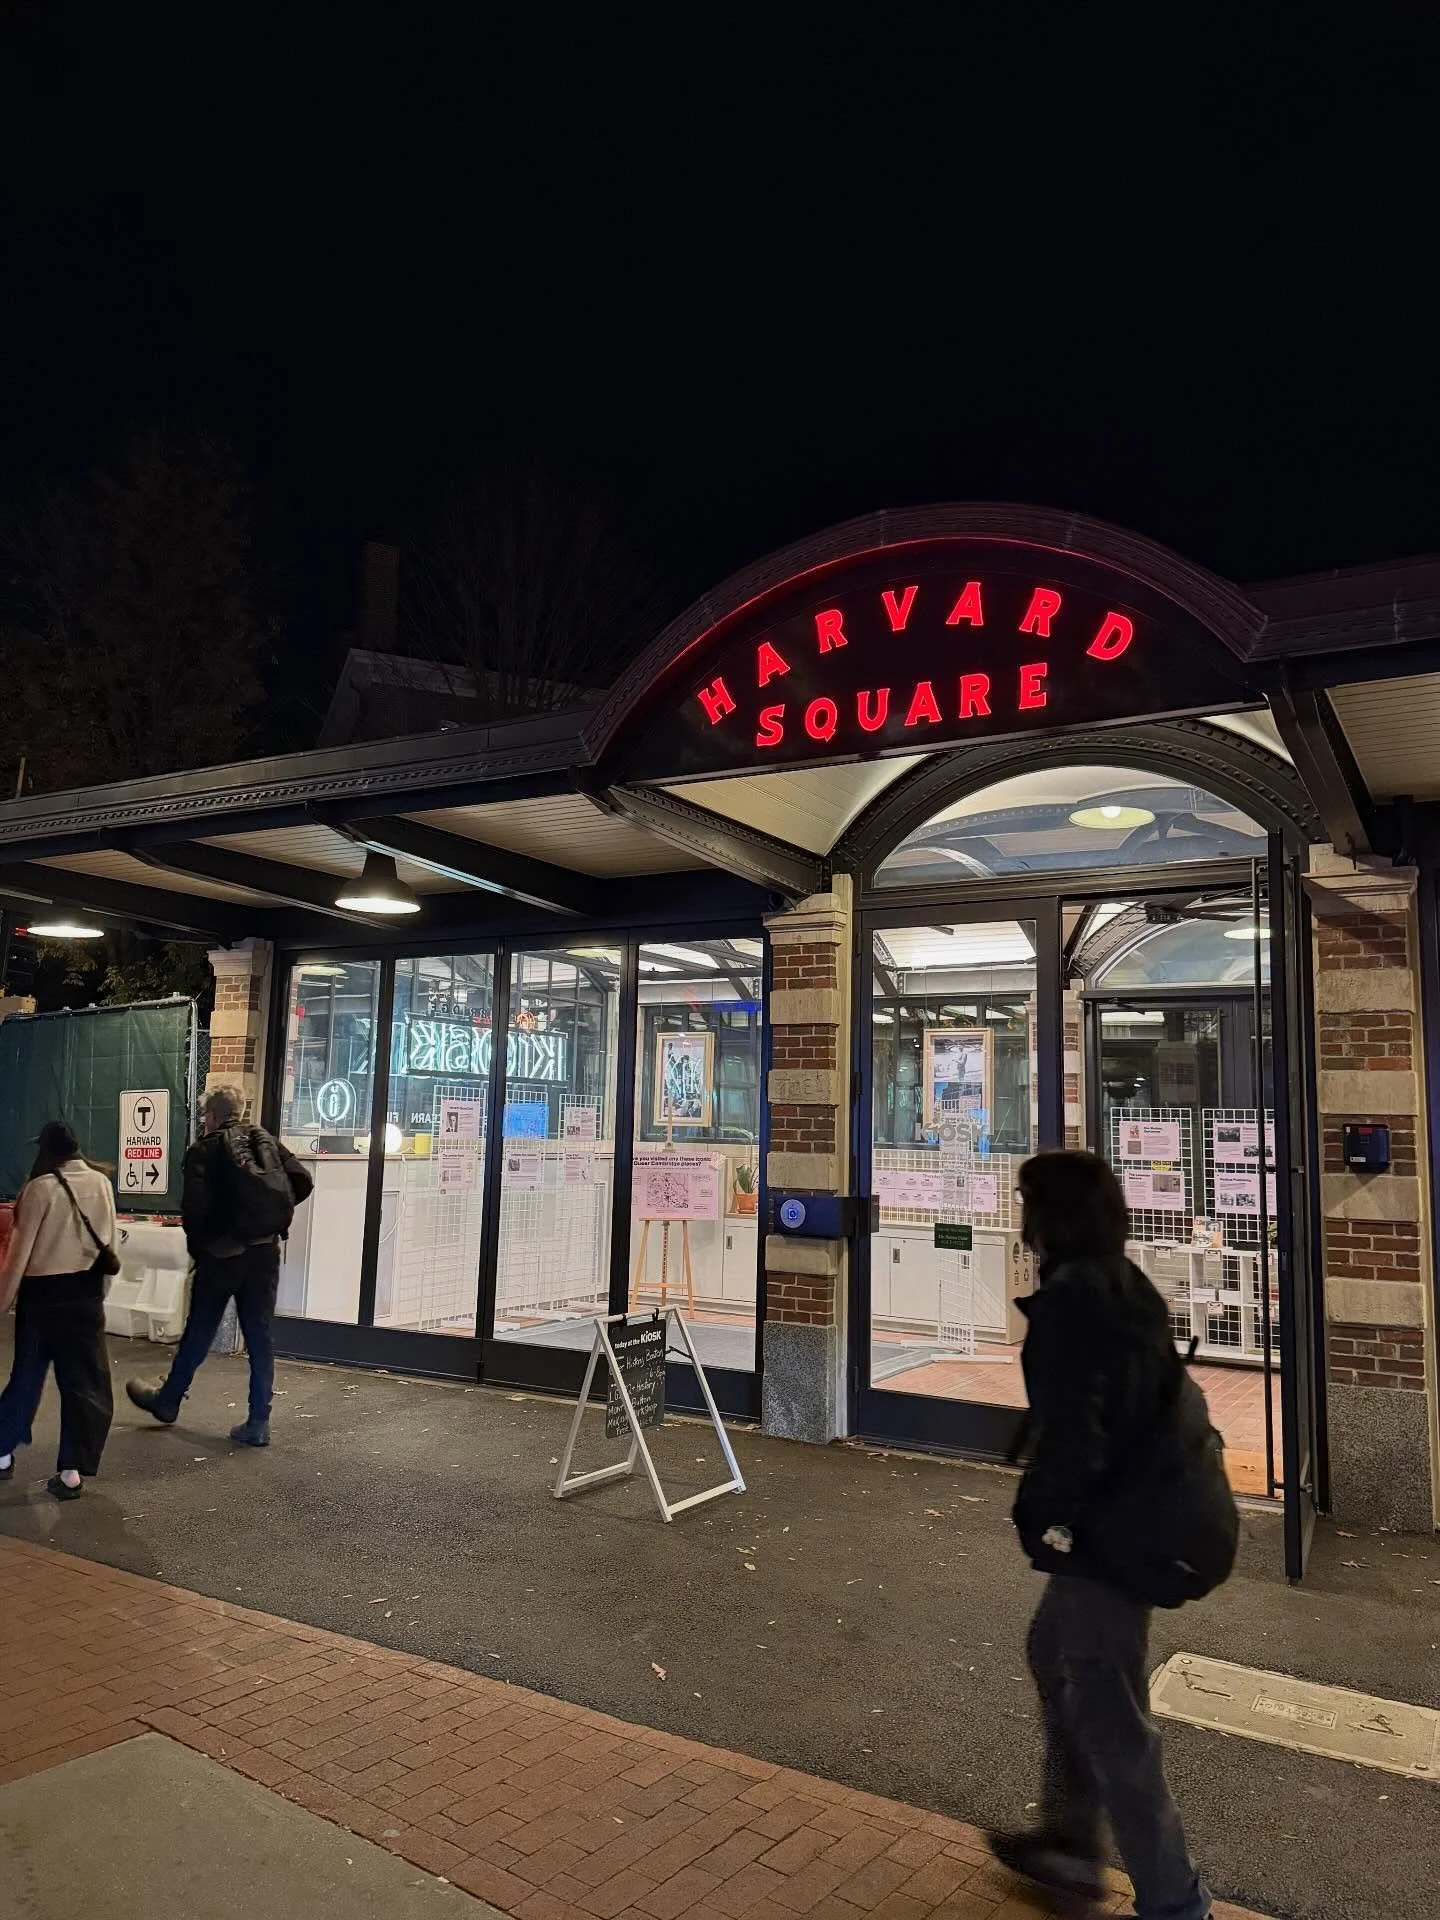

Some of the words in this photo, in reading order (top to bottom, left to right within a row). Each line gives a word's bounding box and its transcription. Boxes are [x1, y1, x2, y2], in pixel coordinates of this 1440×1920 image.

[697, 581, 1134, 724] HARVARD
[756, 662, 1047, 747] SQUARE
[138, 1107, 150, 1126] T
[126, 1136, 161, 1146] HARVARD
[127, 1148, 141, 1158] RED
[143, 1148, 160, 1158] LINE
